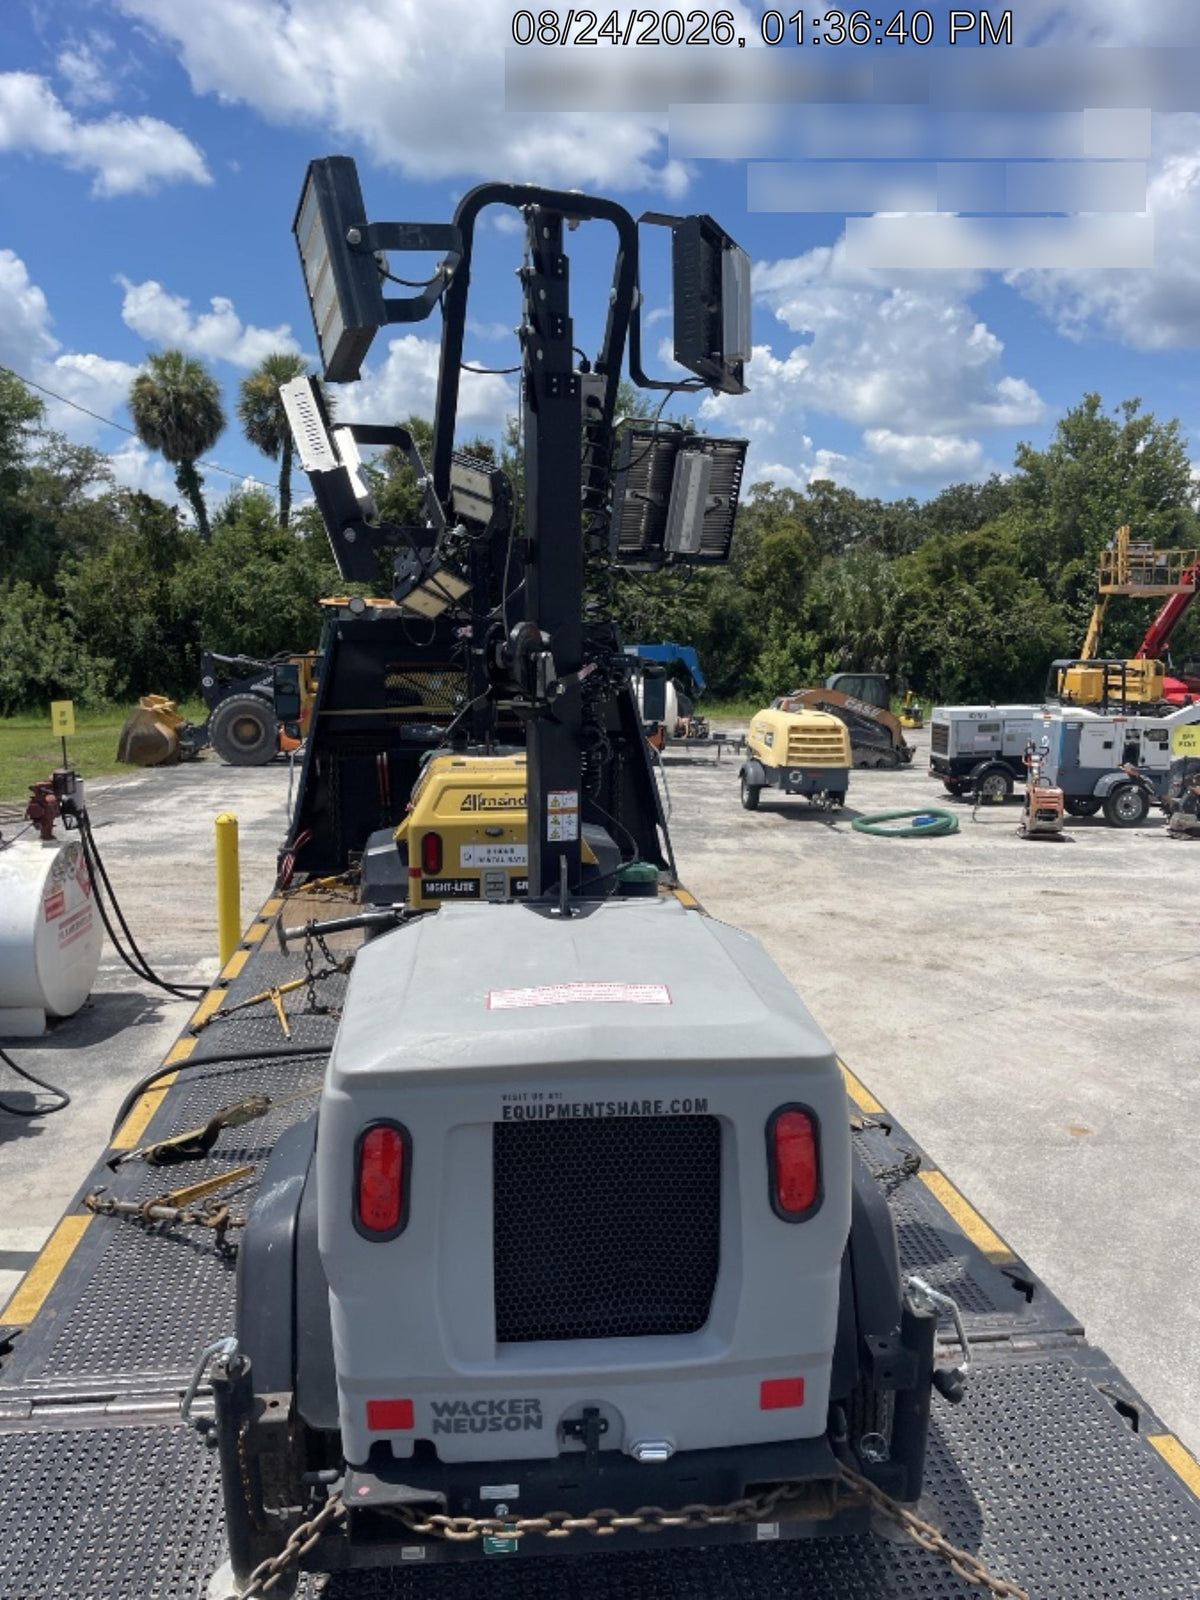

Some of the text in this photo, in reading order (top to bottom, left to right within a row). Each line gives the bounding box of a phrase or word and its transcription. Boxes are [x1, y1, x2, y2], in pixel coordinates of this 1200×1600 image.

[502, 1098, 708, 1121] EQUIPMENTSHARE.COM
[430, 1398, 542, 1418] WACKER
[432, 1414, 543, 1434] NEUSON
